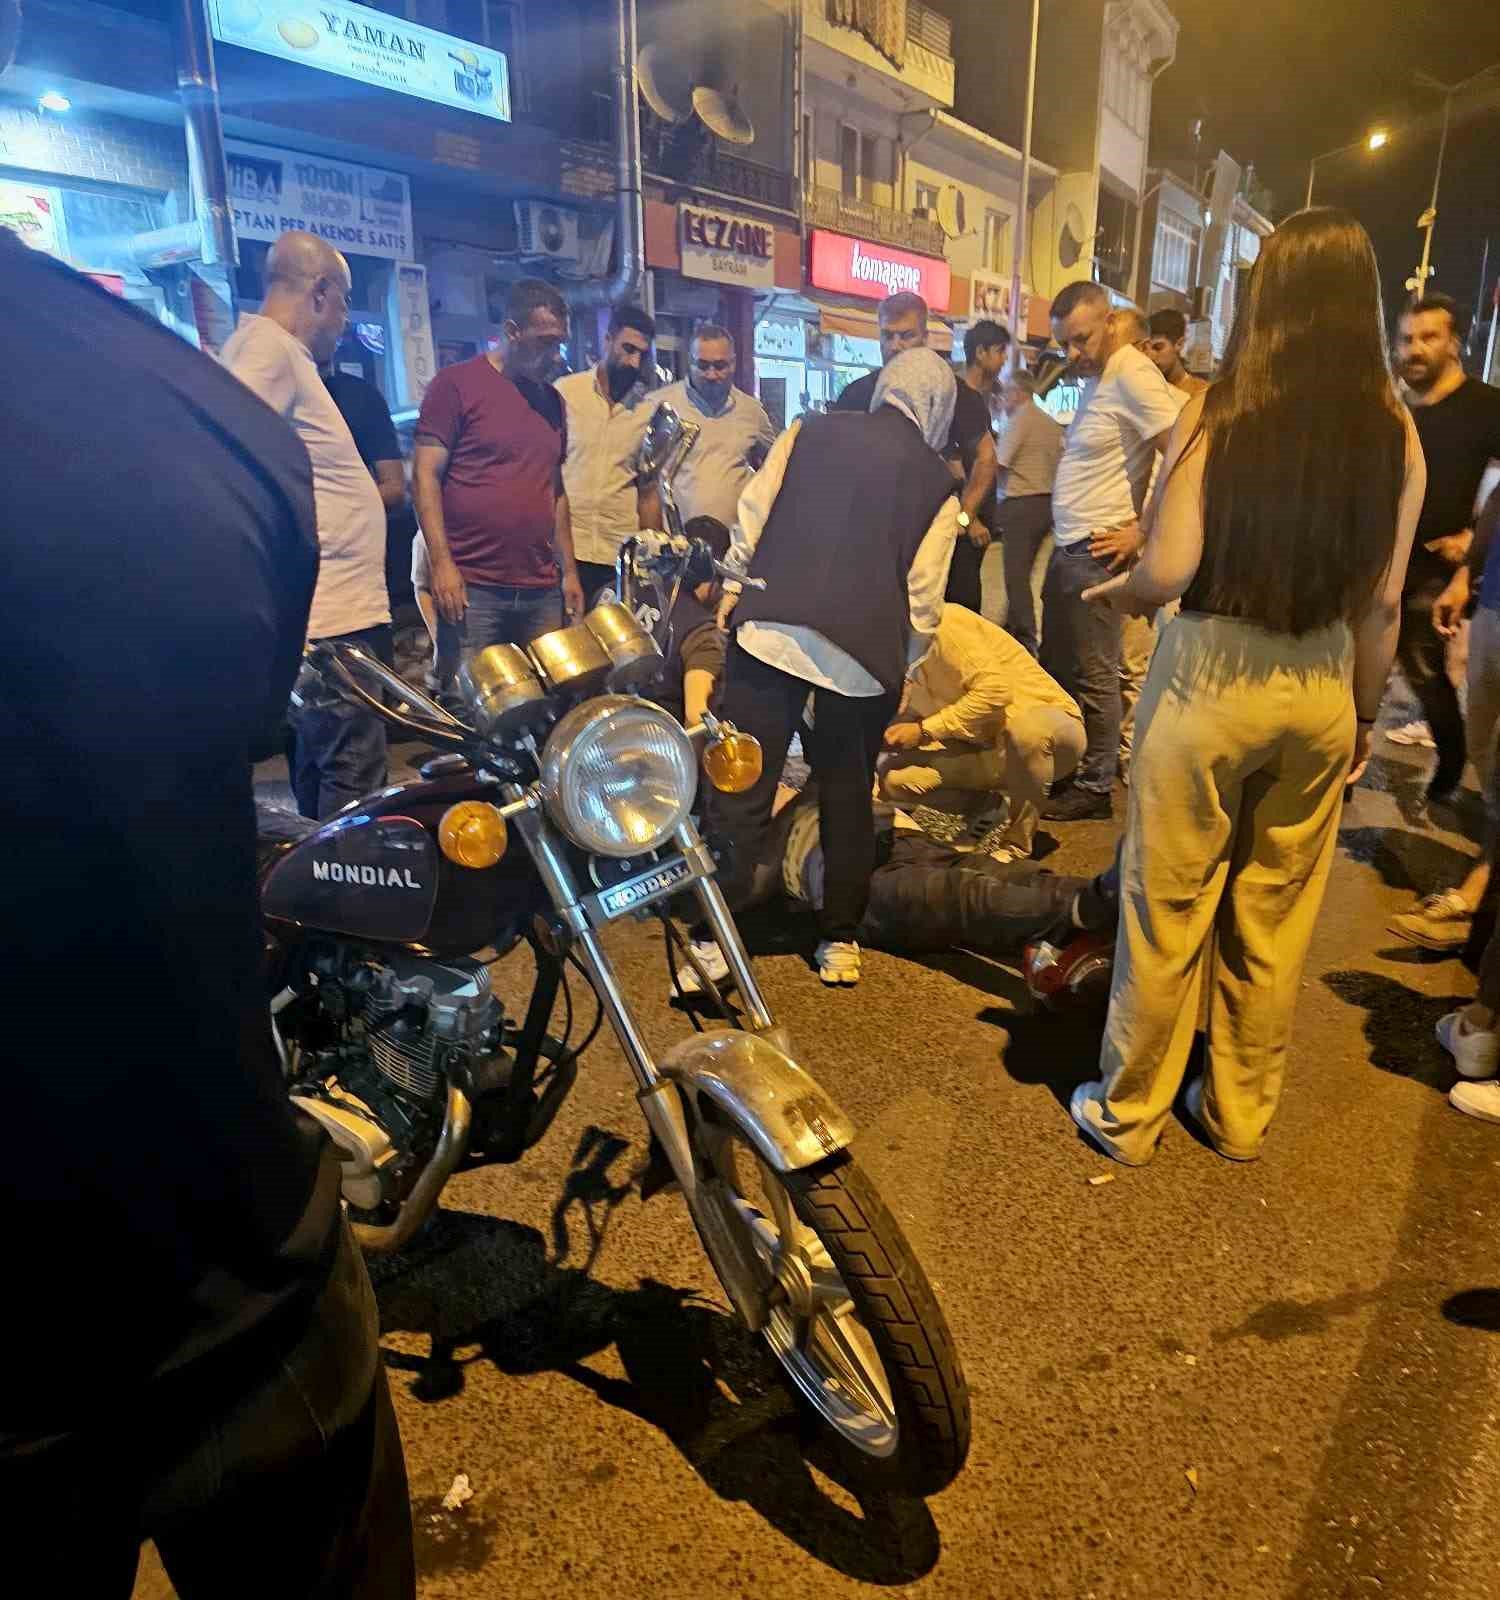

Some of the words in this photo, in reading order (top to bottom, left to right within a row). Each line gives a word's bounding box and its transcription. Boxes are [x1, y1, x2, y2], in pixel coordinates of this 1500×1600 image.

[320, 10, 426, 62] YAMAN
[684, 208, 773, 260] ECZANE
[851, 240, 922, 296] komagene
[312, 859, 422, 889] MONDIAL
[605, 864, 690, 910] MONDIAL
